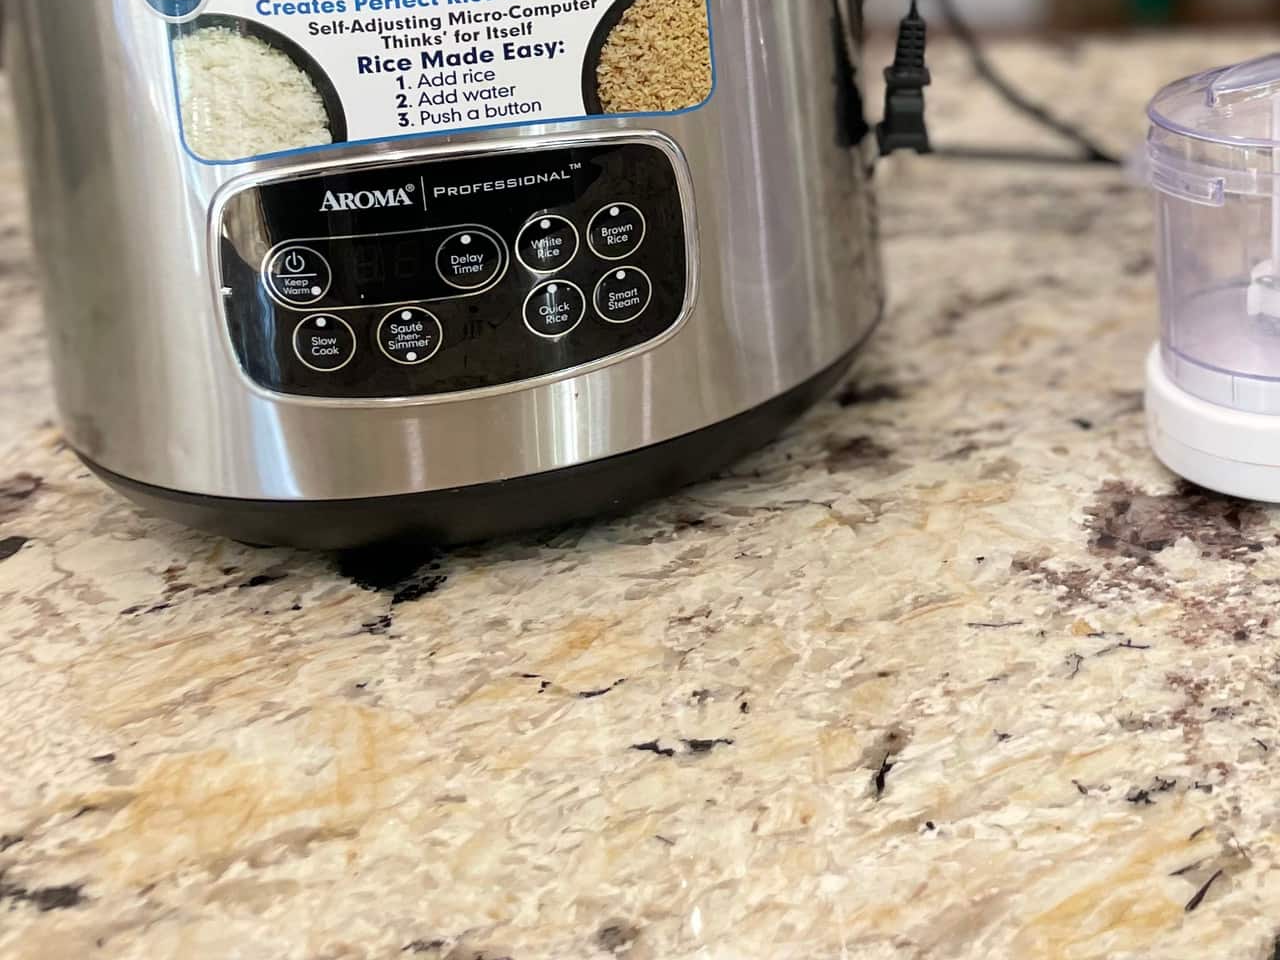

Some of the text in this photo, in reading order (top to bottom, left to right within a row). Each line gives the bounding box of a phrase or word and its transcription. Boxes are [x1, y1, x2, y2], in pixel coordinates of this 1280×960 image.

[308, 0, 598, 36] Self-Adjusting Micro-Computer
[454, 29, 480, 44] for
[486, 21, 533, 40] Itself
[357, 40, 565, 75] Rice Made Easy:
[396, 69, 496, 90] 1. Add rice
[396, 84, 516, 109] 2. Add water
[398, 100, 542, 127] 3. Push a button
[601, 223, 633, 237] Brown
[531, 236, 562, 249] White
[607, 233, 629, 246] Rice
[450, 253, 484, 266] Delay
[537, 248, 560, 259] Rice
[452, 263, 484, 275] Timer
[284, 278, 309, 288] Keep
[283, 286, 310, 296] Warm
[608, 287, 639, 302] Smart
[539, 301, 570, 316] Quick
[608, 296, 640, 311] Steam
[545, 313, 568, 325] Rice
[390, 321, 423, 334] Sauté
[311, 336, 337, 346] Slow
[388, 338, 430, 351] Simmer
[311, 345, 340, 357] Cook
